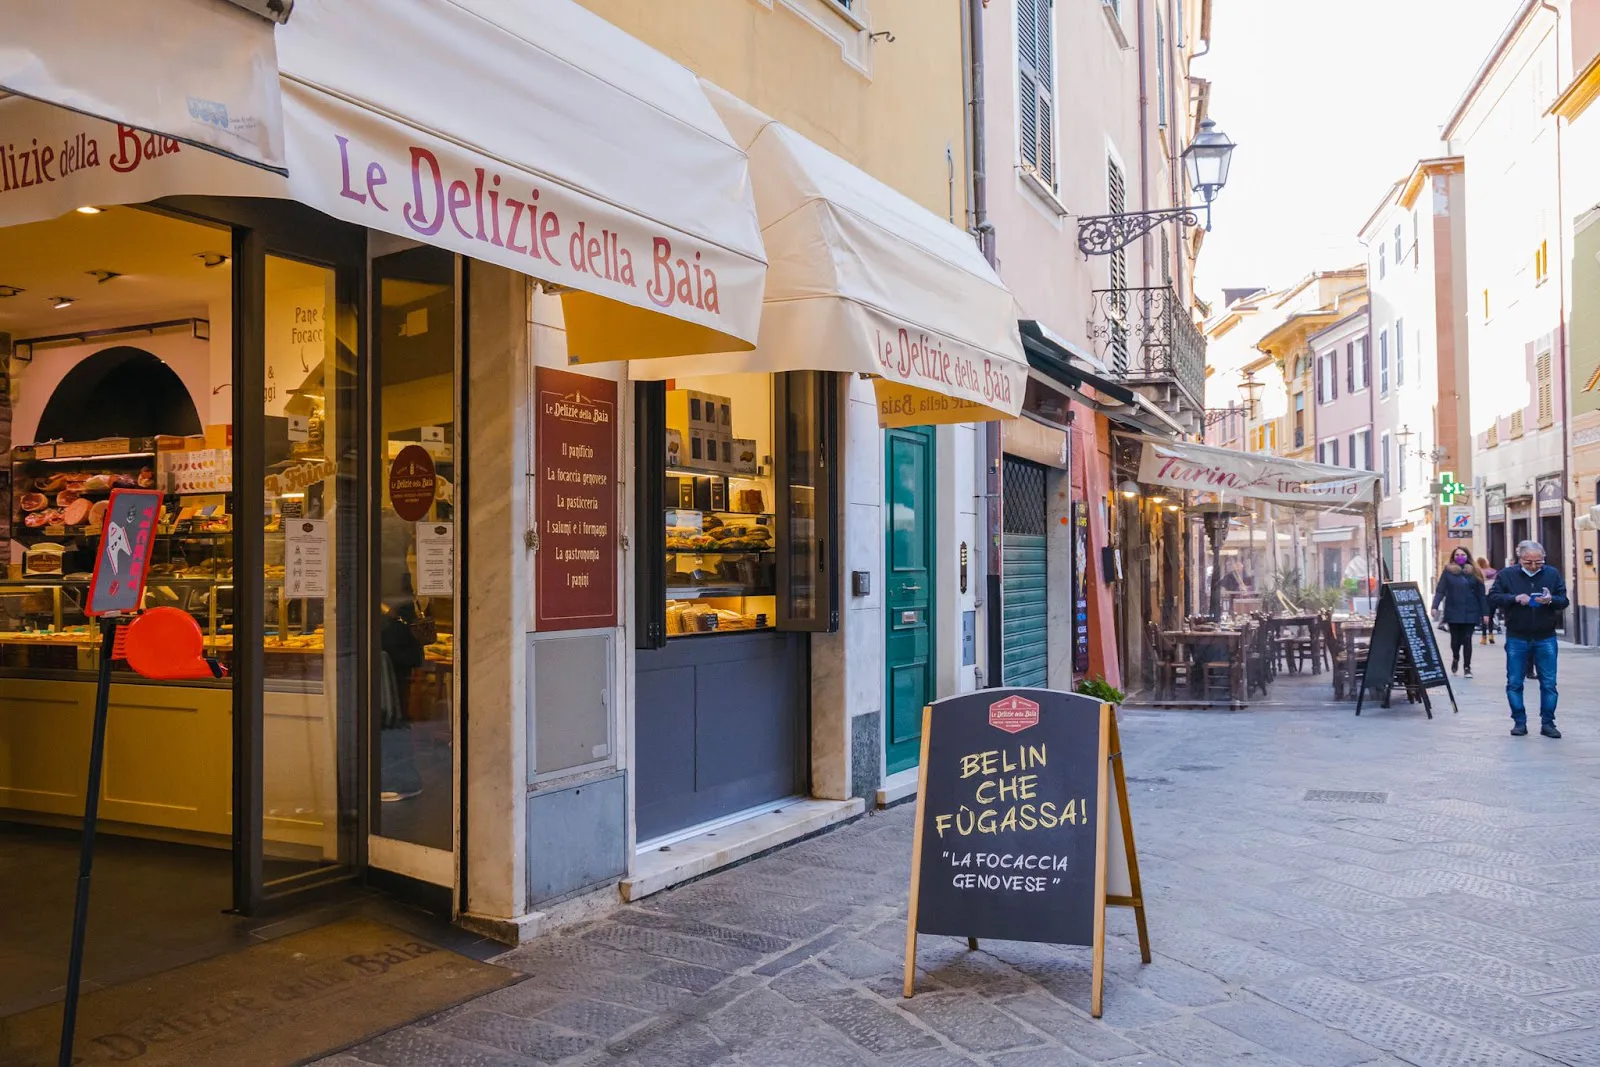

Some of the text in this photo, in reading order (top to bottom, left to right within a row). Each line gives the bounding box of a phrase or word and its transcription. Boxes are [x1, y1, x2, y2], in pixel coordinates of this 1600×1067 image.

[60, 132, 100, 178] della
[334, 134, 720, 315] Le Delizie della Baia
[295, 307, 318, 325] Pane
[876, 328, 1011, 404] Le Delizie della Baia
[545, 402, 609, 423] Le Delizie della Baia
[562, 442, 594, 460] Il panificio
[547, 467, 607, 486] La focaccia genovese
[1155, 453, 1241, 489] Turin
[557, 494, 599, 510] La pasticceria
[551, 521, 571, 536] salumi
[573, 523, 577, 534] e
[582, 521, 608, 537] formaggi
[126, 505, 154, 591] TICKET
[555, 546, 600, 562] La gastronomia
[571, 572, 589, 588] panini
[959, 742, 1047, 779] BELIN
[975, 774, 1038, 805] CHE
[976, 852, 1068, 872] FOCACCIA
[340, 940, 440, 977] Baia
